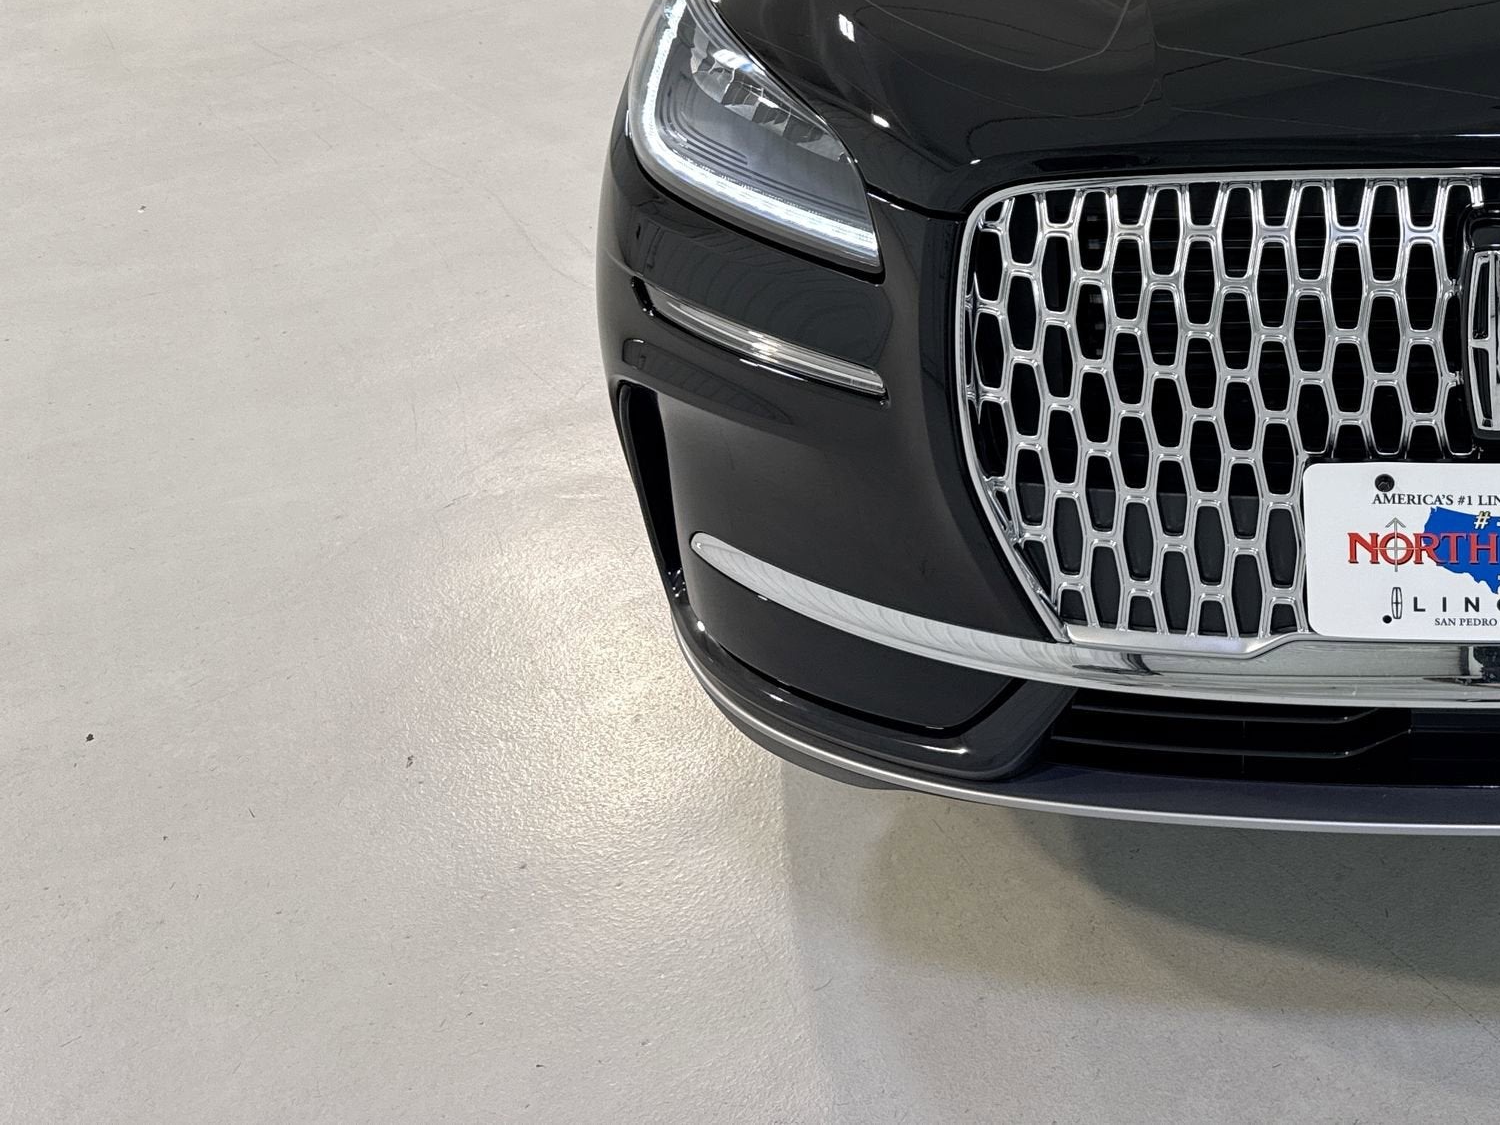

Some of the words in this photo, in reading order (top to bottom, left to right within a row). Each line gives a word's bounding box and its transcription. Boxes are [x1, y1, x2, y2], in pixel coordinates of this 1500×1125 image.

[1373, 493, 1453, 507] AMERICA'S
[1457, 495, 1473, 506] #1
[1347, 532, 1499, 565] NORTH
[1434, 618, 1457, 627] SAN
[1459, 618, 1498, 627] PEDRO
